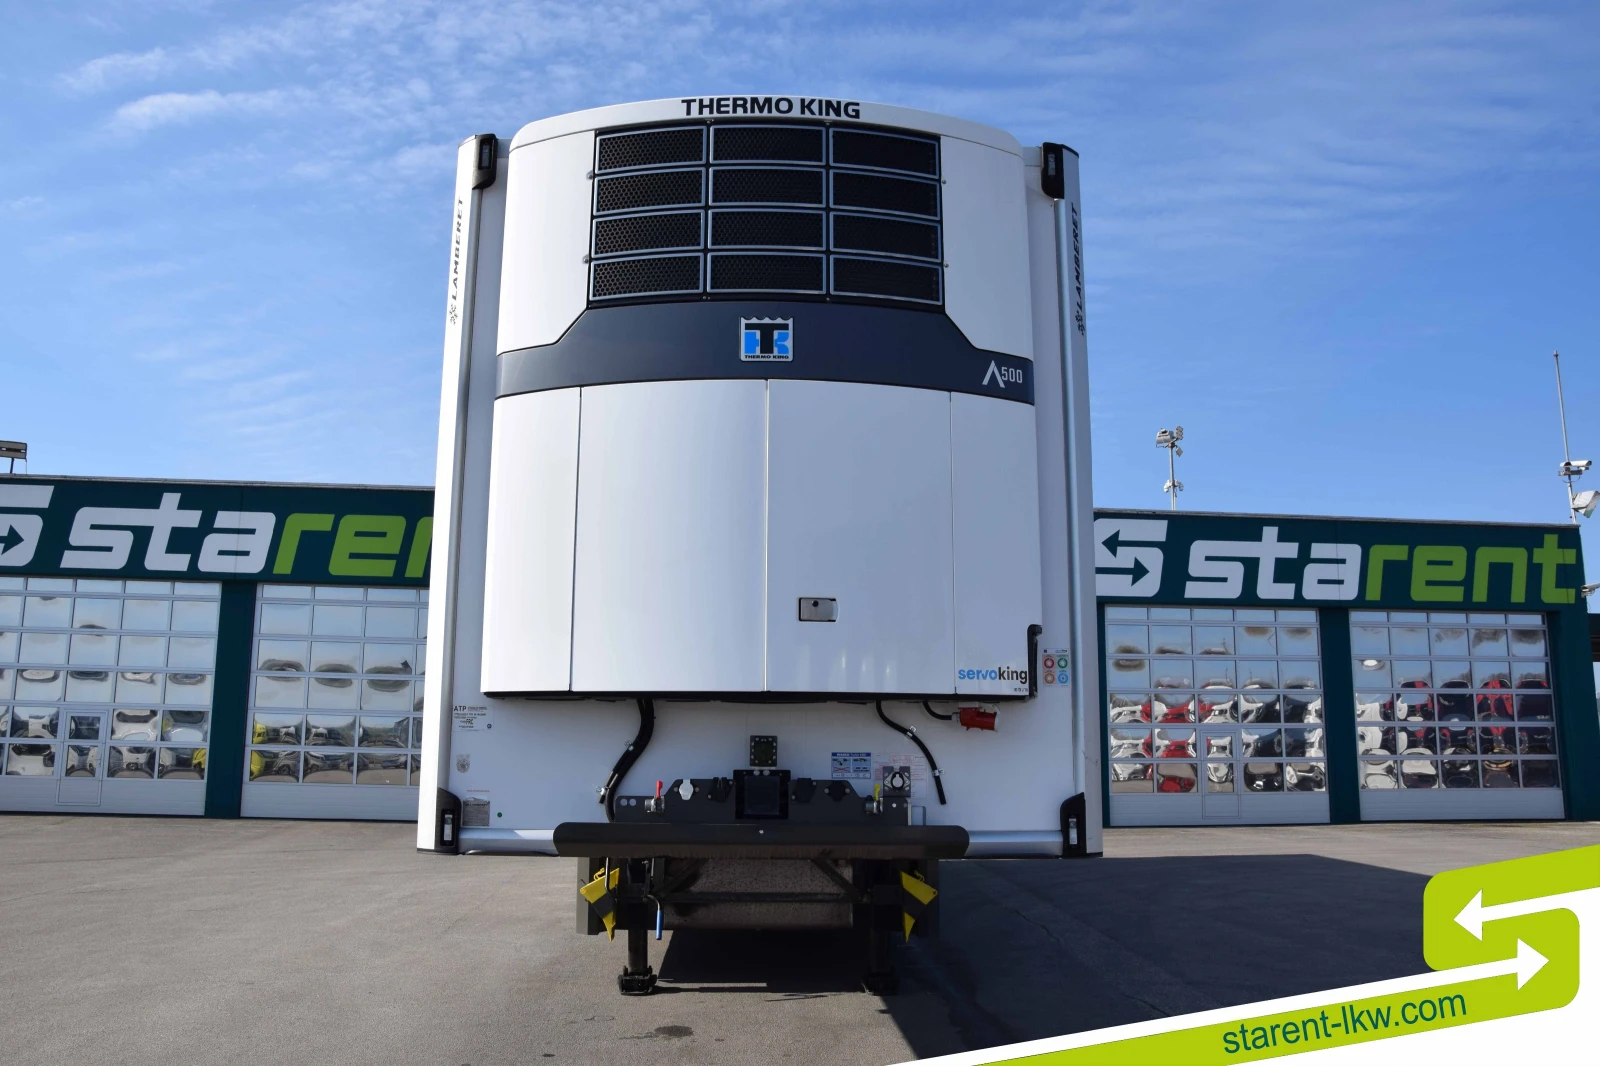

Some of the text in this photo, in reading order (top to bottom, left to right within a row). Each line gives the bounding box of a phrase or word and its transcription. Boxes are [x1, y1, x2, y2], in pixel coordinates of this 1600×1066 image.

[681, 97, 860, 119] THERMO KING
[452, 197, 463, 301] LAMBERET
[1071, 202, 1083, 311] LAMBERET
[1184, 526, 1576, 604] starent
[958, 666, 1028, 684] servoking
